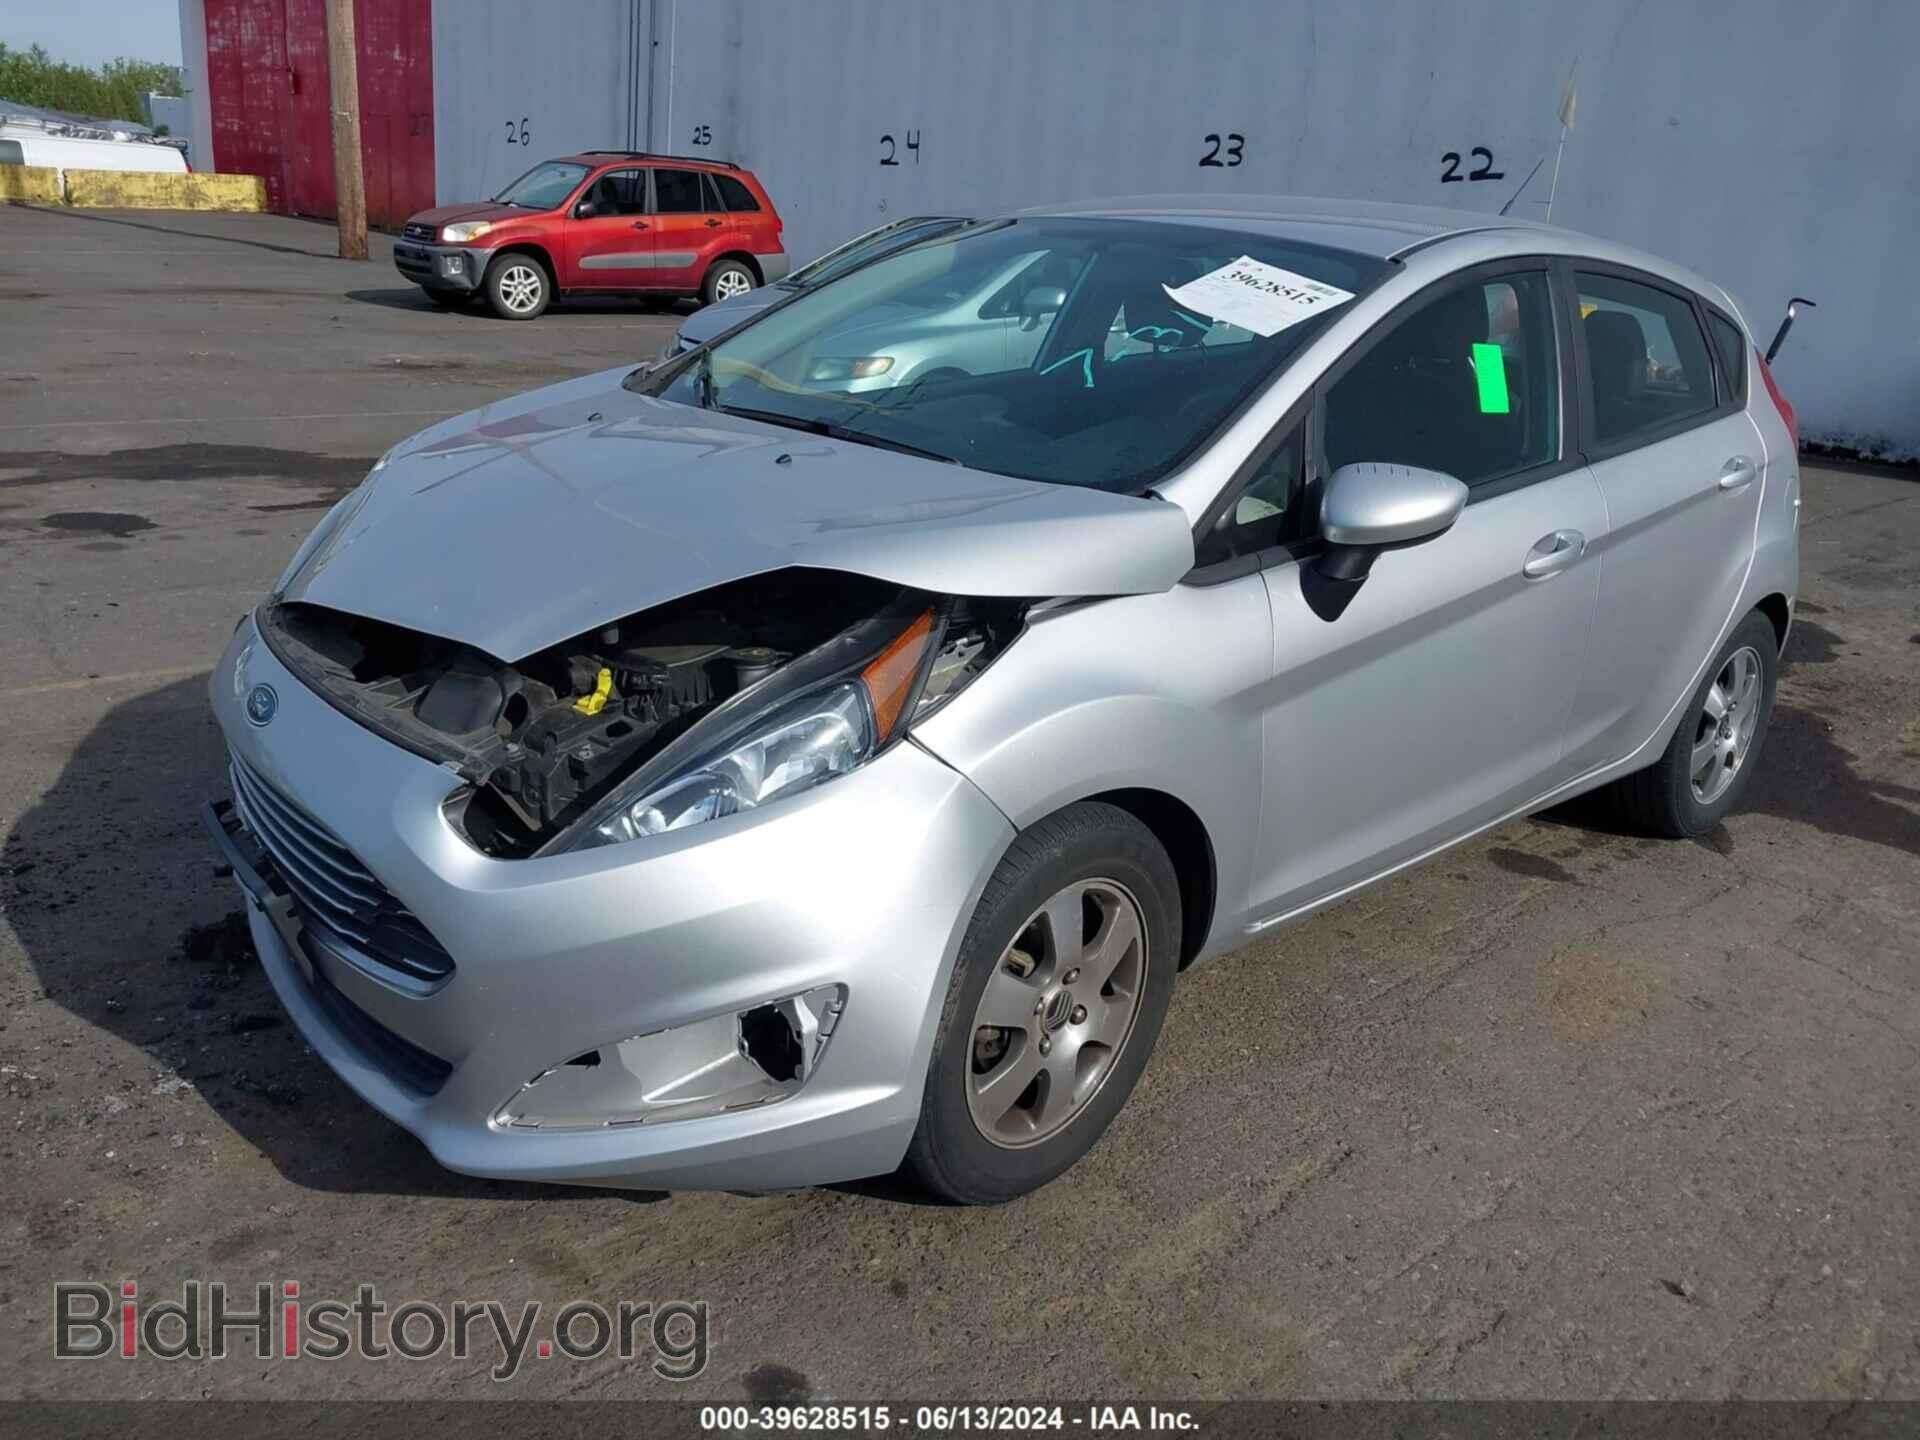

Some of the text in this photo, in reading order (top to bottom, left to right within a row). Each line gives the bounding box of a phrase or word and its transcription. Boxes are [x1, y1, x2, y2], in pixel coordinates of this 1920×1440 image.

[505, 118, 530, 146] 26
[691, 125, 713, 146] 25
[879, 130, 921, 166] 24
[1198, 133, 1246, 168] 23
[1440, 146, 1505, 184] 22
[1221, 270, 1321, 305] 39628515
